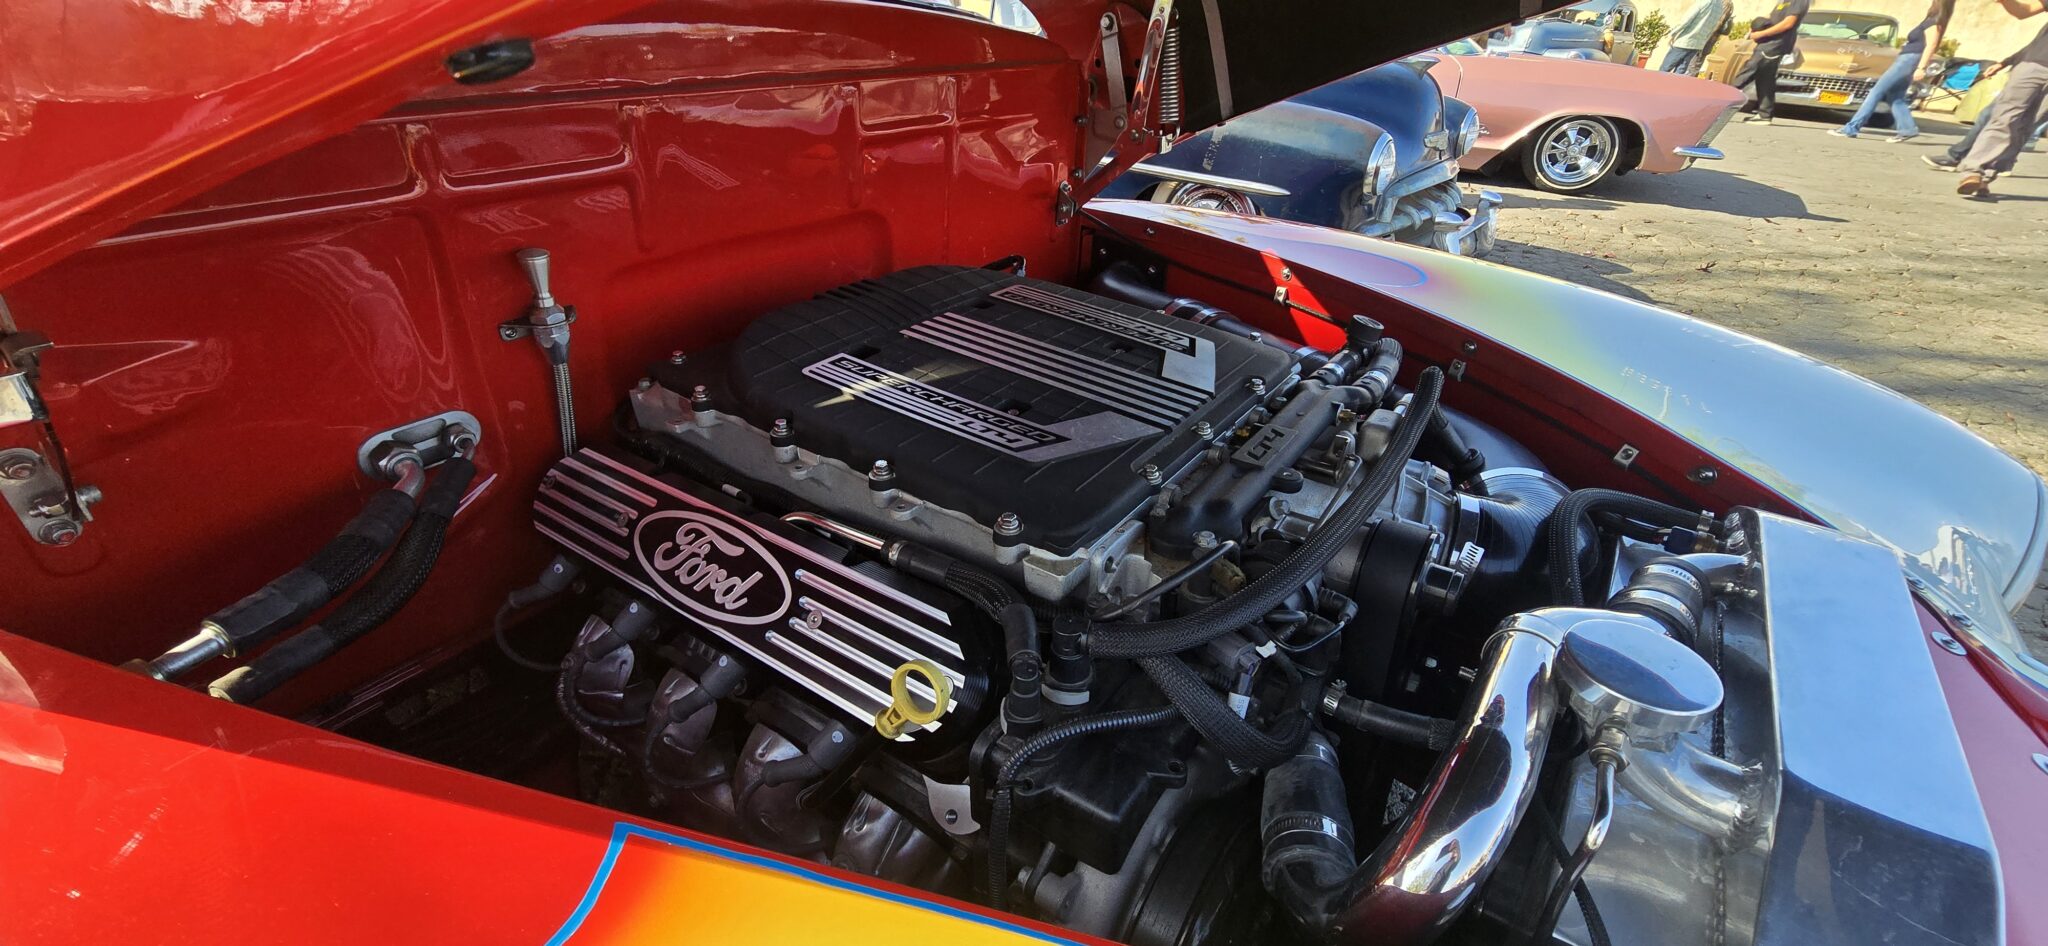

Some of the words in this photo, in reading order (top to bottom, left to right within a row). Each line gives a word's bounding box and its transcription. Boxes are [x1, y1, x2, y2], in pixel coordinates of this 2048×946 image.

[835, 360, 1057, 441] SUPERCHARGED
[958, 420, 1023, 443] LT4
[1246, 427, 1285, 461] LT4
[654, 521, 764, 610] Ford
